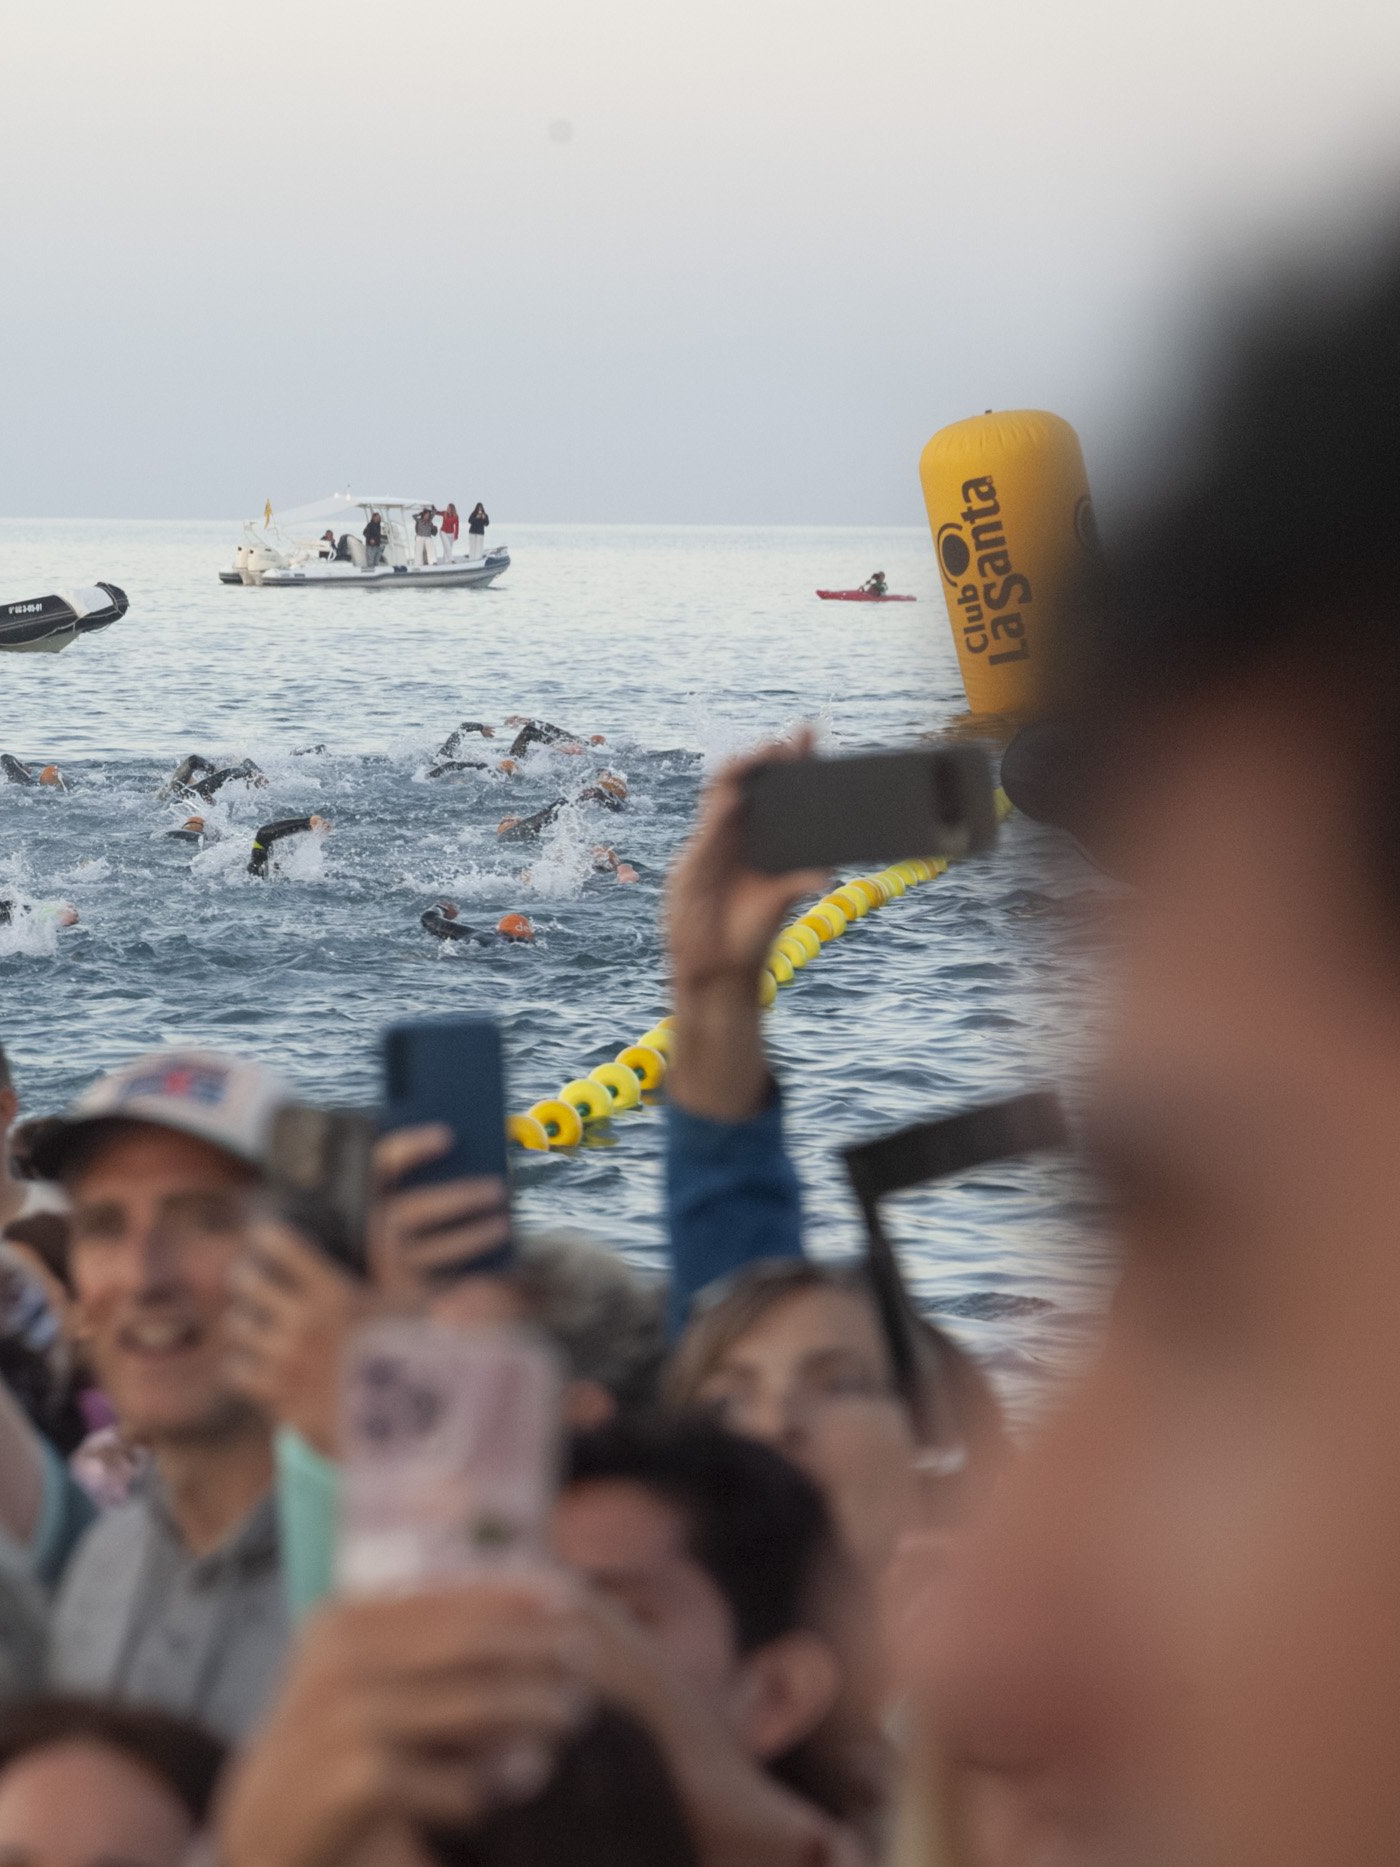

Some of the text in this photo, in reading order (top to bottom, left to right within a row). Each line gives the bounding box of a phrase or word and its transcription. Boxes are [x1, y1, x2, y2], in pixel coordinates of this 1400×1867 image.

[957, 583, 989, 654] Club
[960, 474, 1033, 666] La Santa
